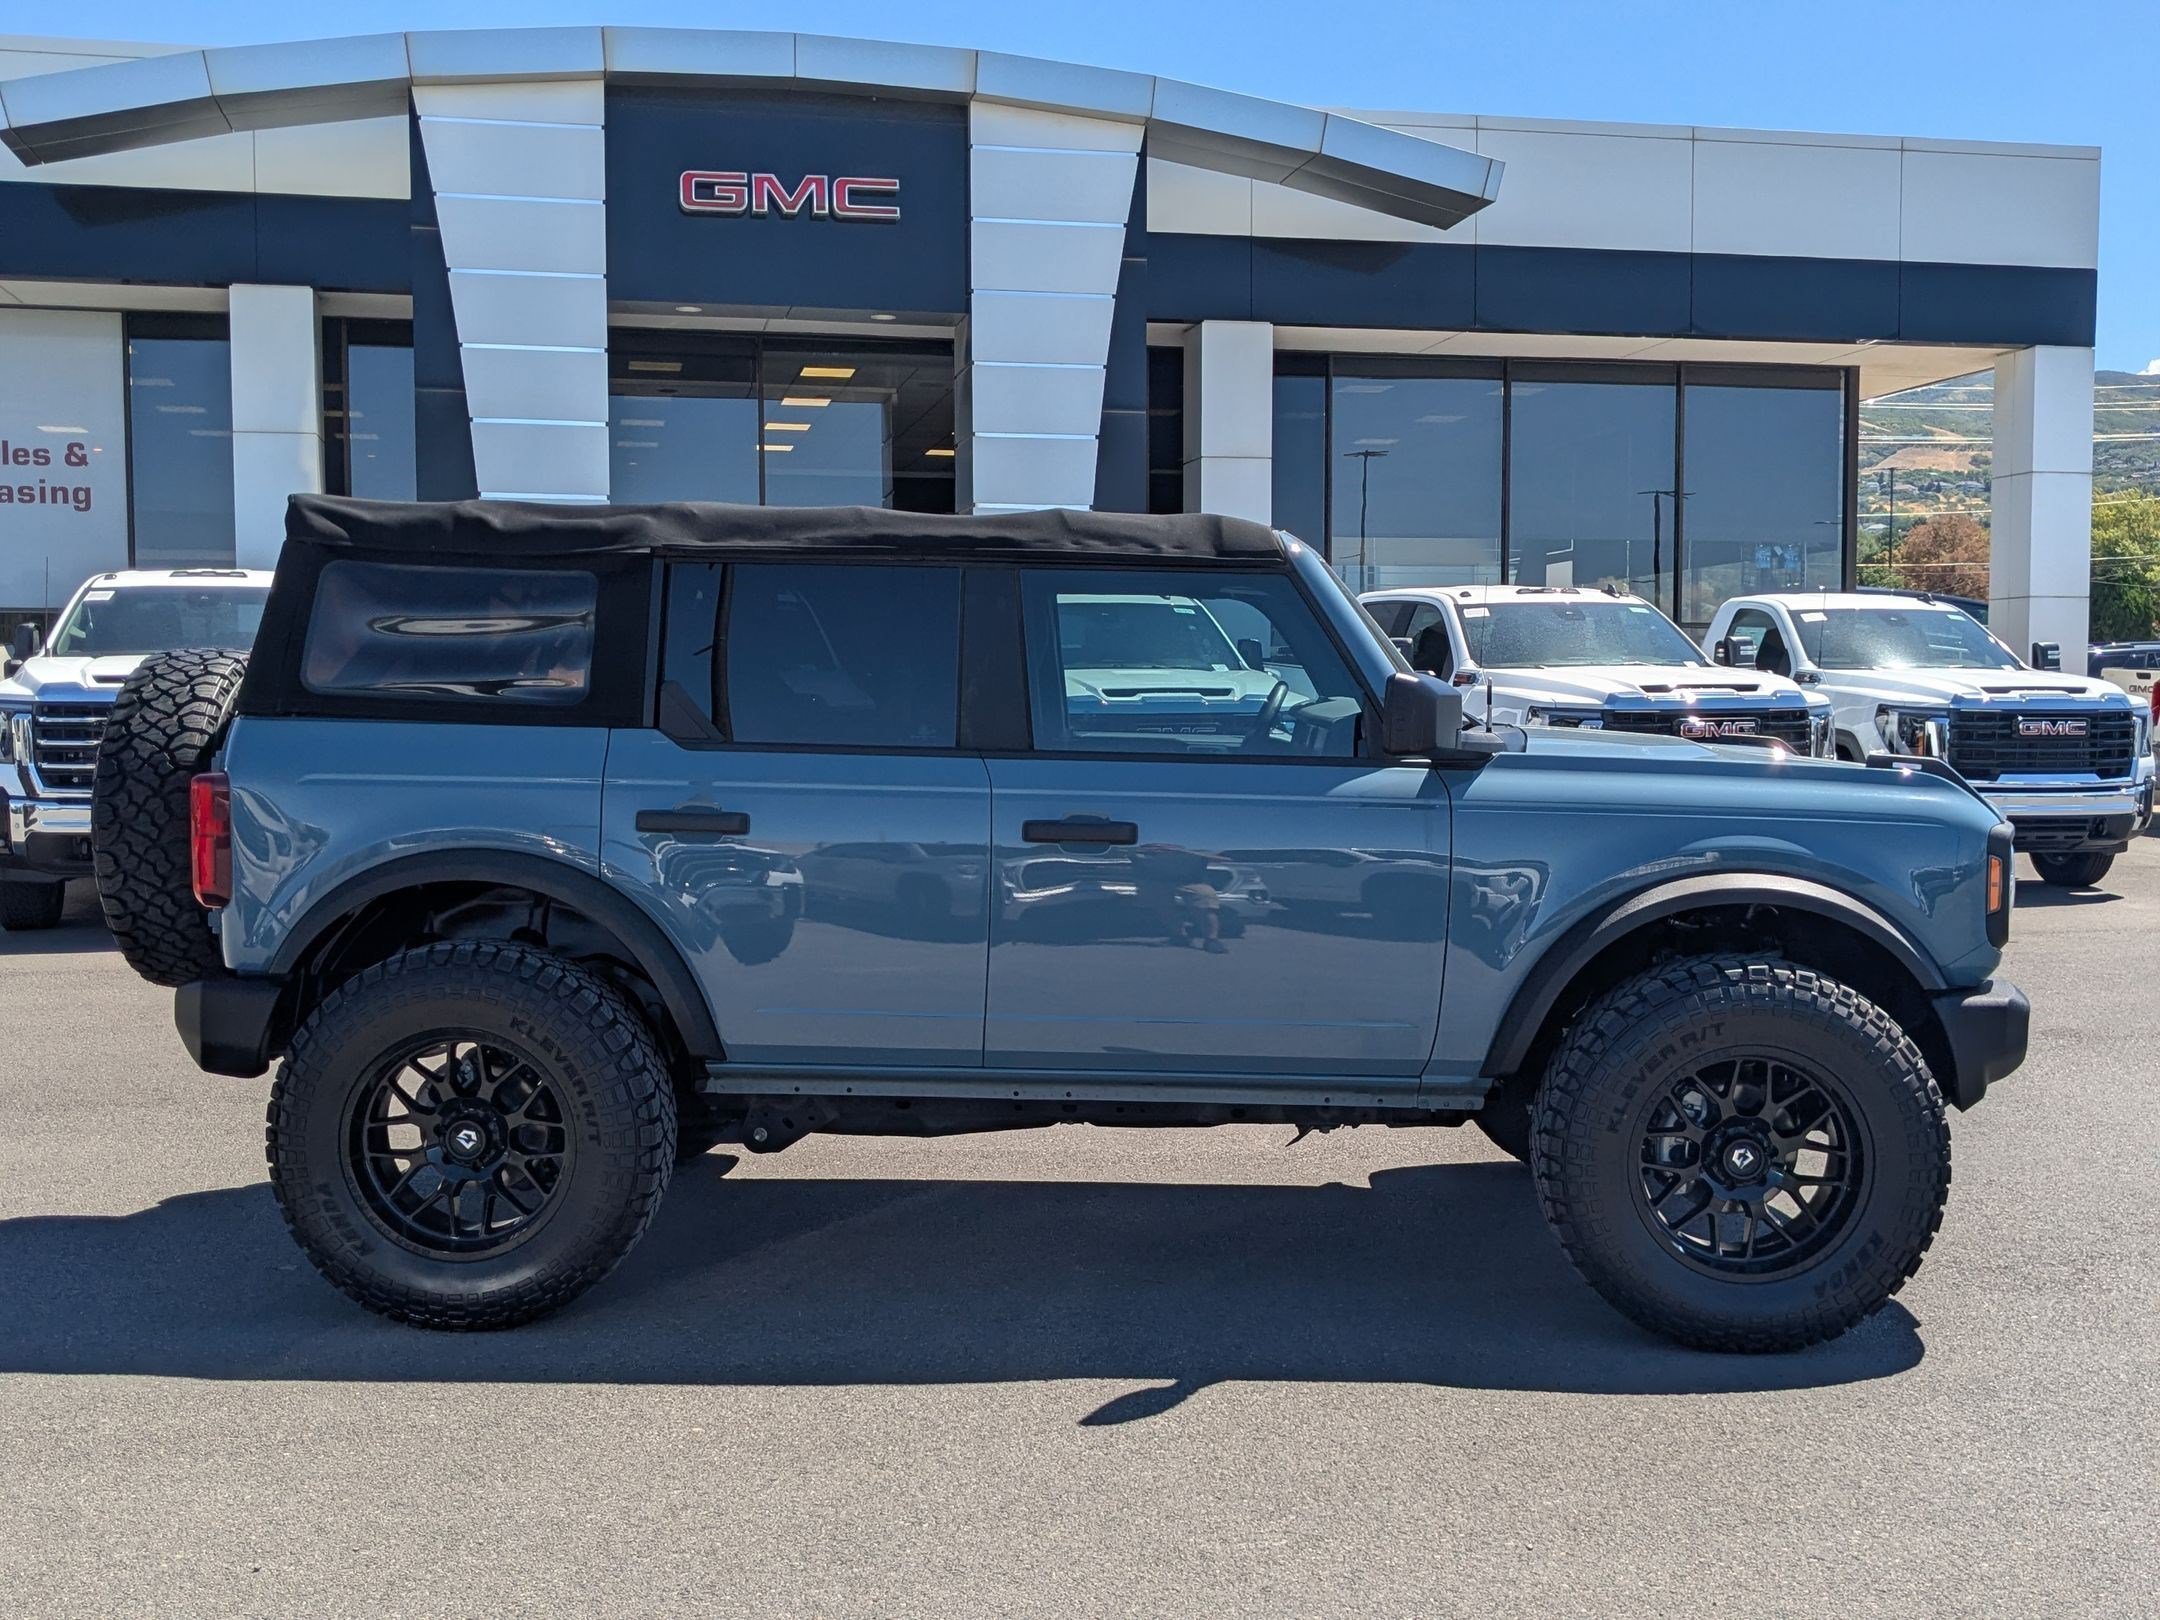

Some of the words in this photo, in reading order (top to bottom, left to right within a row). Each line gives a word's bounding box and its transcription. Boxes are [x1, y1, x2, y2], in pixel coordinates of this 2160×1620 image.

[680, 170, 900, 221] GMC
[64, 442, 88, 467] &
[2129, 684, 2153, 694] GMC
[1680, 721, 1756, 738] GMC
[2019, 720, 2087, 736] GMC
[509, 1014, 588, 1098] KLEVER
[1606, 1042, 1677, 1134] KLEVER
